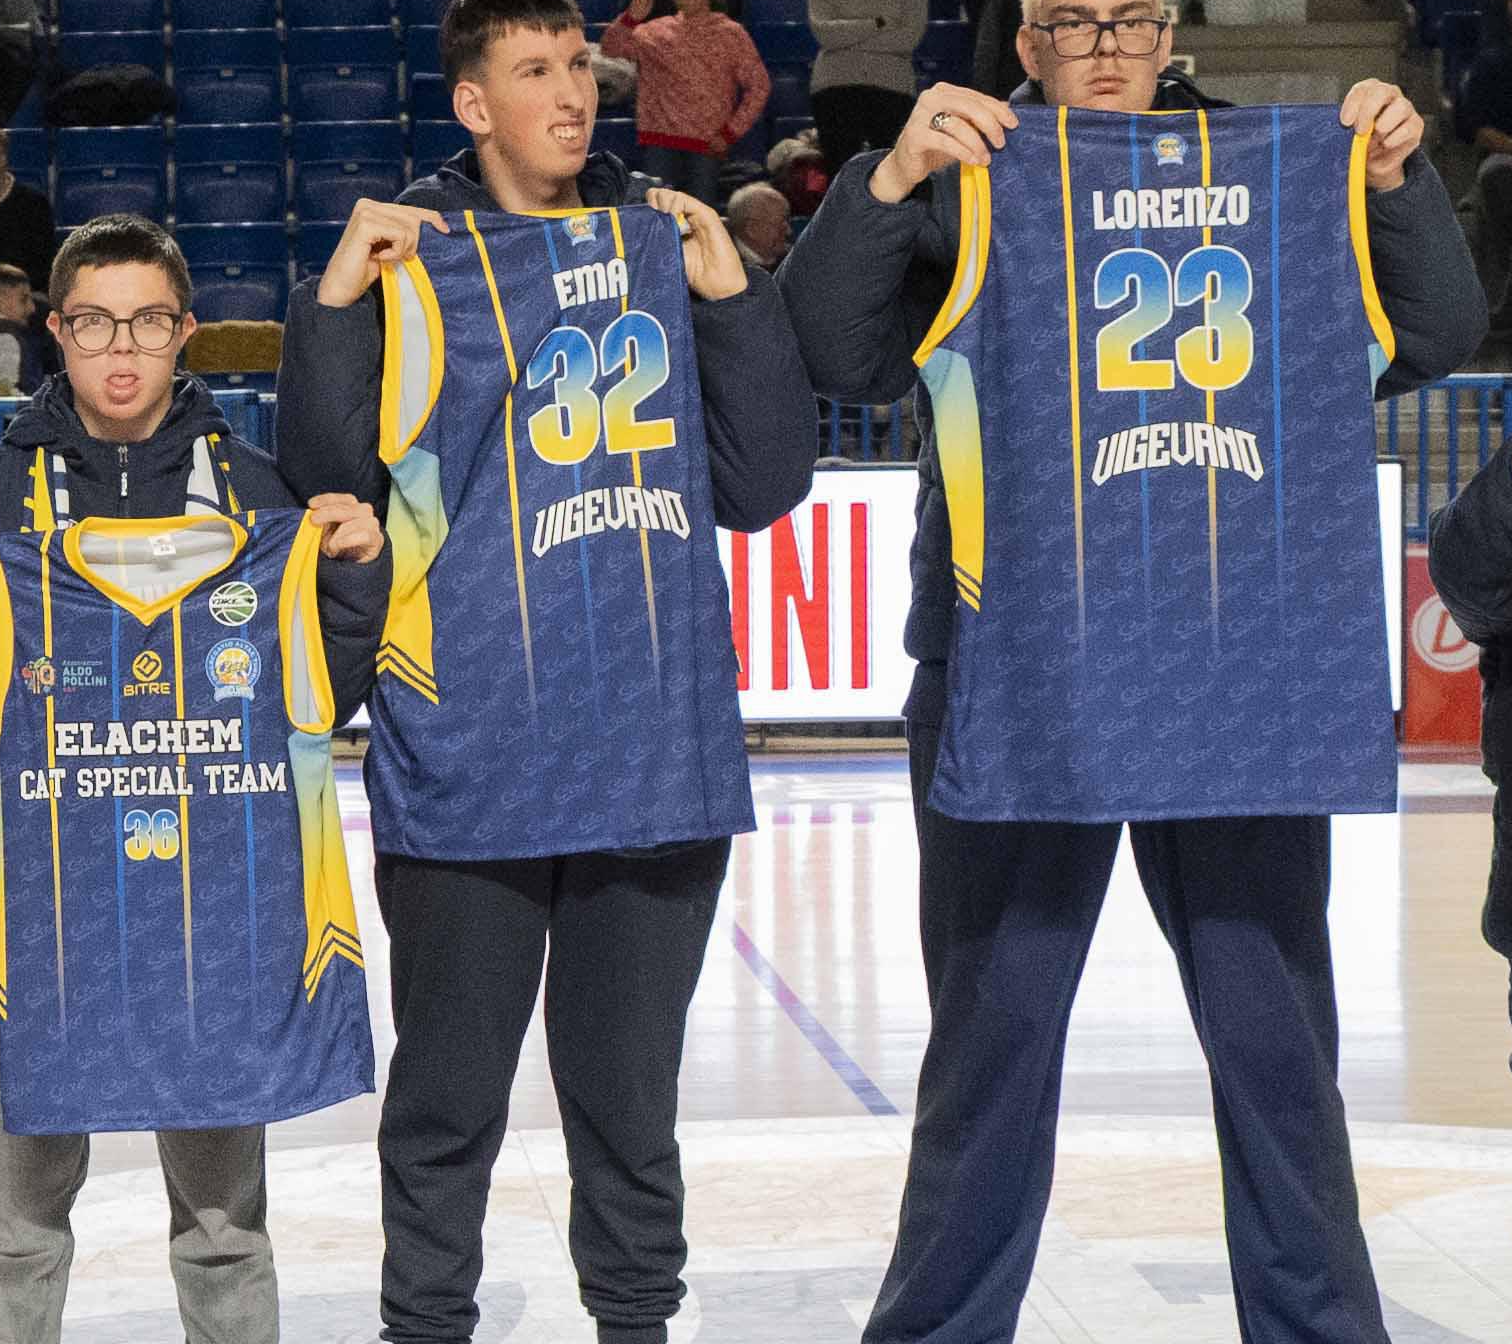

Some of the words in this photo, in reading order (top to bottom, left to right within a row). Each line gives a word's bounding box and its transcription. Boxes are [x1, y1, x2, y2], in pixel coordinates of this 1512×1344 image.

[1092, 185, 1250, 230] LORENZO
[552, 258, 629, 311] EMA
[1093, 244, 1254, 391] 23
[526, 310, 677, 465] 32
[1091, 421, 1265, 487] VIGEVANO
[531, 485, 691, 558] VIGEVANO
[62, 667, 94, 677] ALDO
[63, 674, 108, 687] POLLINI
[123, 682, 171, 697] BITRE
[54, 718, 243, 758] ELACHEM
[19, 767, 67, 801] CAT
[75, 765, 194, 798] SPECIAL
[204, 761, 288, 796] TEAM
[124, 808, 181, 861] 36
